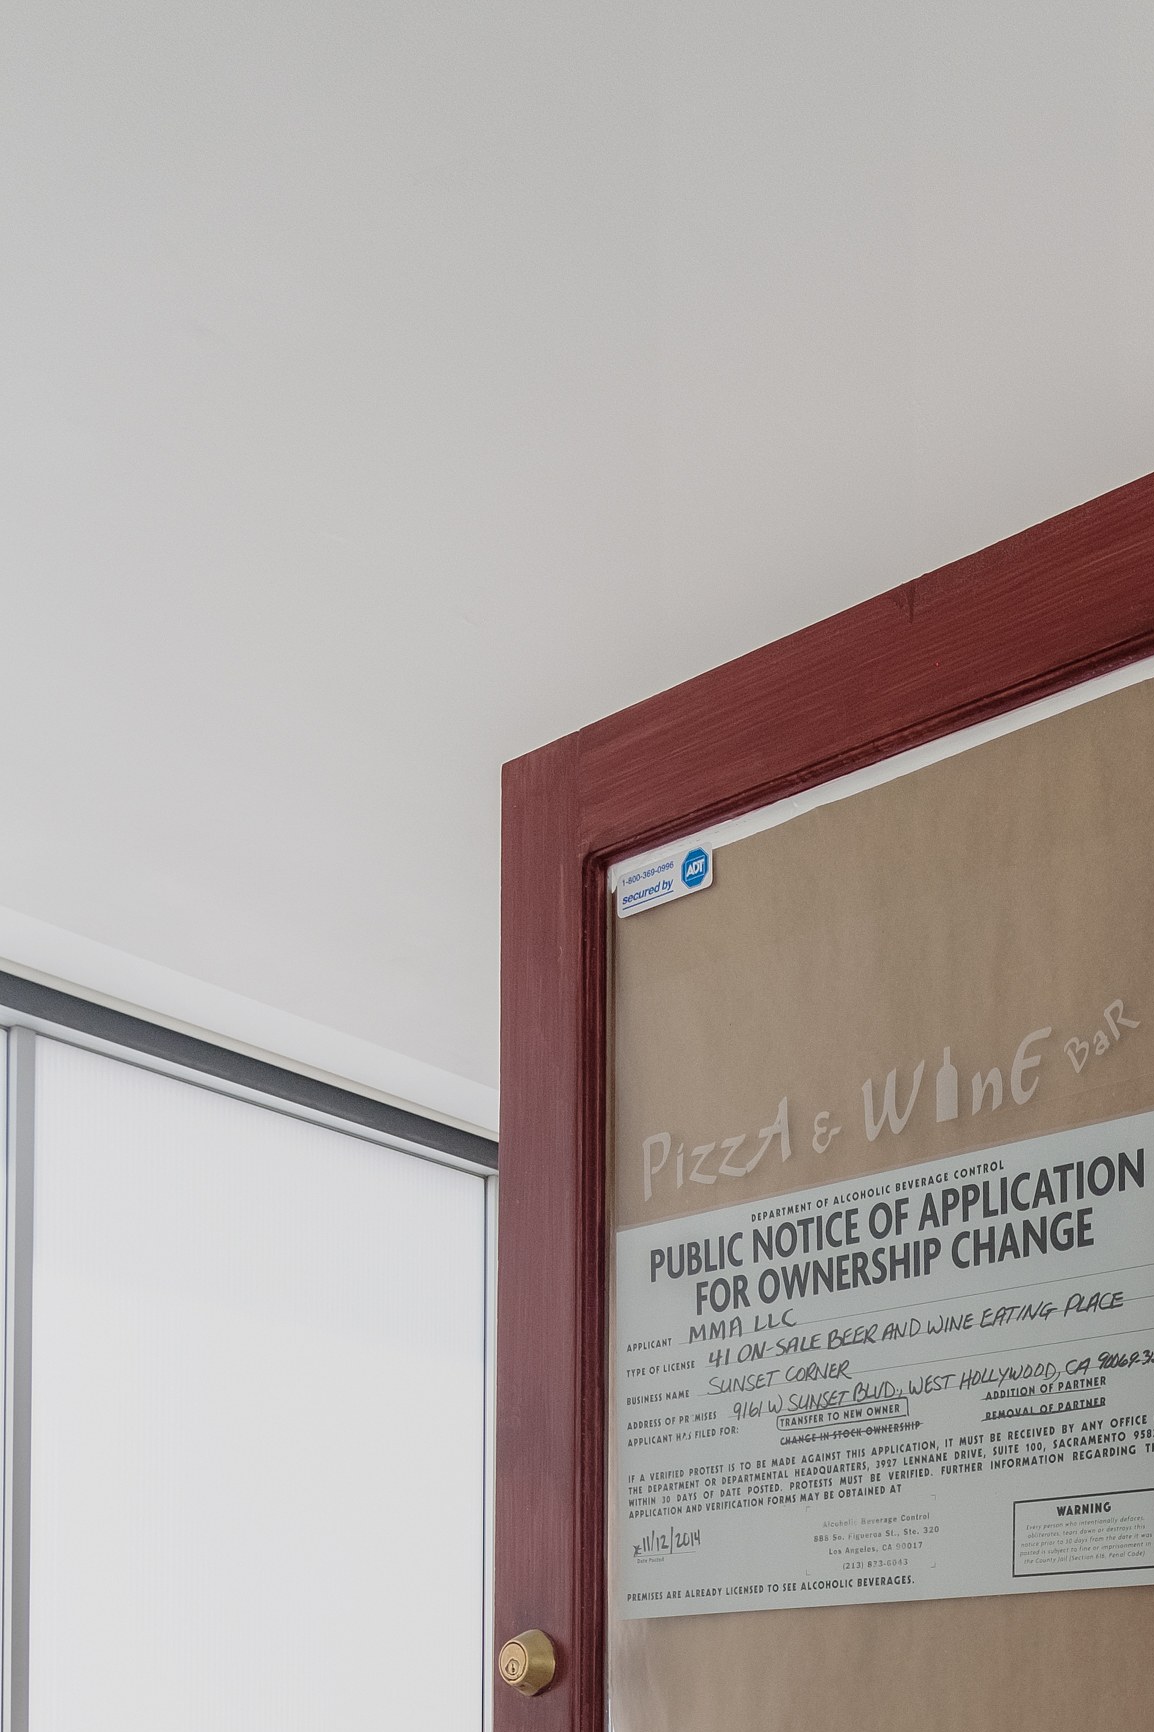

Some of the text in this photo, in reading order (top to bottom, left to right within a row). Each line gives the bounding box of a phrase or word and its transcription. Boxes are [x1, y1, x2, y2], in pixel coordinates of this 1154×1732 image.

[686, 858, 705, 878] ADT
[622, 879, 674, 905] secured by
[811, 1111, 842, 1154] &
[751, 1159, 1005, 1223] DEPARTMENT OF ALCOHOLIC BEVERAGE CONTROL
[650, 1147, 1145, 1283] PUBLIC NOTICE OF APPLICATION
[696, 1206, 1095, 1316] FOR OWNERSHIP CHANGE
[688, 1307, 797, 1345] MMA LLC
[708, 1347, 731, 1368] 41
[826, 1323, 879, 1351] BEER
[881, 1317, 922, 1342] AND
[926, 1312, 974, 1335] WINE
[979, 1300, 1058, 1329] EATING
[1063, 1291, 1124, 1318] PLACE
[626, 1337, 673, 1353] APPLICANT
[626, 1360, 696, 1378] TYPE OF LICENSE
[706, 1359, 853, 1396] SUNSET CORNER
[626, 1389, 690, 1406] BUSINESS NAME
[733, 1400, 763, 1421] 9161
[768, 1393, 783, 1414] W
[787, 1390, 851, 1412] SUNSET
[908, 1373, 957, 1396] WEST
[958, 1361, 1063, 1392] HOLLYWOOD,
[1065, 1357, 1091, 1376] CA
[626, 1410, 717, 1431] ADDRESS OF PRMISES
[779, 1403, 900, 1428] TRANSFER TO NEW OWNER
[627, 1433, 673, 1447] APPLICANT
[694, 1428, 717, 1439] FILED
[719, 1425, 739, 1436] FOR:
[628, 1474, 636, 1484] IF
[639, 1473, 646, 1483] A
[649, 1469, 685, 1481] VERIFIED
[688, 1464, 724, 1477] PROTEST
[728, 1462, 735, 1473] IS
[739, 1461, 752, 1471] TO
[756, 1459, 767, 1470] BE
[771, 1456, 796, 1468] MADE
[800, 1450, 842, 1464] AGAINST
[845, 1447, 866, 1459] THIS
[870, 1439, 940, 1457] APPLICATION,
[944, 1437, 954, 1448] IT
[958, 1434, 984, 1447] MUST
[989, 1432, 1002, 1443] BE
[1007, 1425, 1056, 1441] RECEIVED
[1061, 1423, 1075, 1435] BY
[1080, 1419, 1104, 1433] ANY
[1109, 1414, 1148, 1429] OFFICE
[628, 1485, 643, 1496] THE
[647, 1479, 700, 1494] DEPARTMENT
[704, 1477, 717, 1487] OR
[721, 1469, 789, 1485] DEPARTMENTAL
[794, 1460, 870, 1478] HEADQUARTERS,
[875, 1458, 898, 1469] 3927
[903, 1451, 948, 1466] LENNANE
[954, 1447, 987, 1461] DRIVE,
[992, 1443, 1020, 1457] SUITE
[1025, 1441, 1047, 1453] 100,
[1052, 1431, 1127, 1450] SACRAMENTO
[628, 1496, 656, 1507] WITHIN
[661, 1495, 671, 1504] 30
[676, 1491, 697, 1503] DAYS
[702, 1490, 715, 1500] OF
[719, 1487, 741, 1498] DATE
[747, 1483, 783, 1496] POSTED.
[789, 1477, 833, 1491] PROTESTS
[839, 1474, 863, 1486] MUST
[869, 1472, 882, 1483] BE
[888, 1467, 934, 1481] VERIFIED.
[940, 1461, 983, 1476] FURTHER
[990, 1452, 1064, 1470] INFORMATION
[1072, 1444, 1137, 1462] REGARDING
[628, 1483, 902, 1520] APPLICATION AND VERIFICATION FORMS MAY BE OBTAINED AT
[1056, 1501, 1112, 1517] WARNING
[626, 1574, 915, 1602] PREMISES ARE ALREADY LICENSED TO SEE ALCOHOLIC BEVERAGES.
